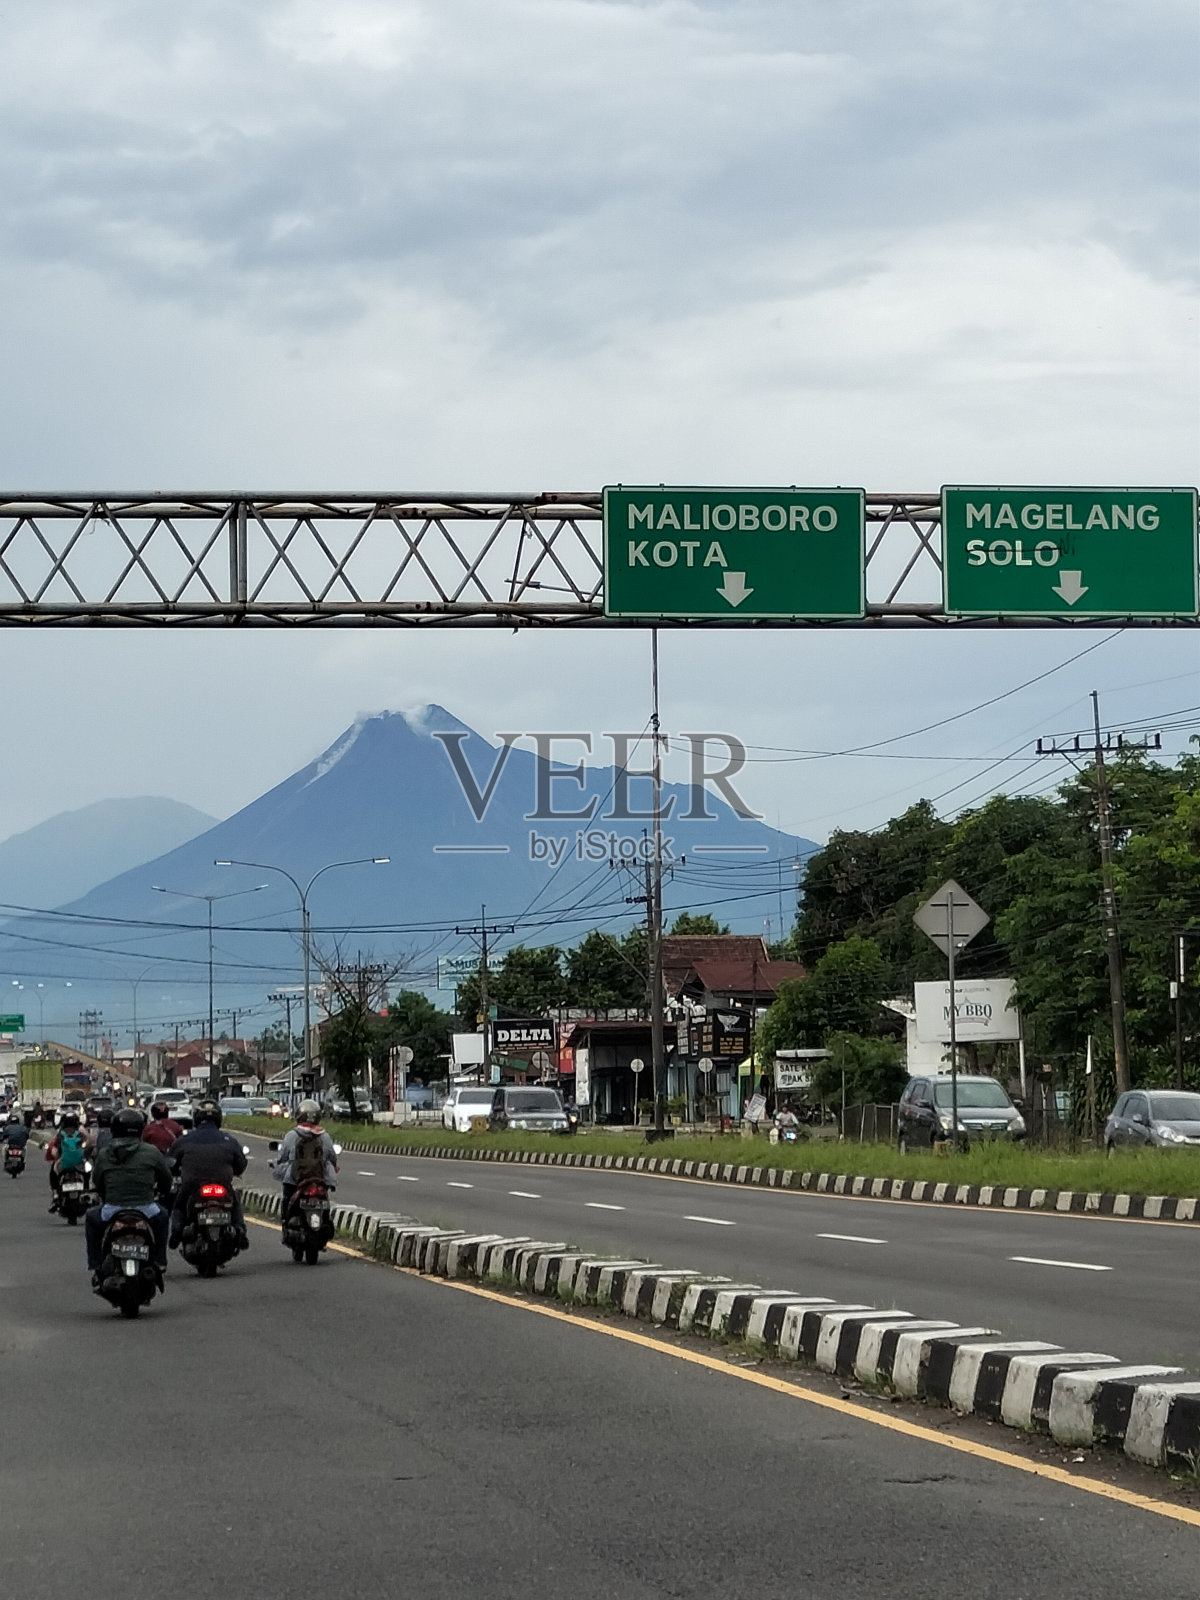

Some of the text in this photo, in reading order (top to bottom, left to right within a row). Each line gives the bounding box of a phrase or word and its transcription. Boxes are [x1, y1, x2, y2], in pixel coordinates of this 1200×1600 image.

[628, 503, 838, 533] MALIOBORO
[965, 503, 1160, 531] MAGELANG
[627, 540, 728, 568] KOTA
[966, 539, 1060, 567] SOLO
[966, 1003, 993, 1021] BBQ
[497, 1028, 552, 1042] DELTA
[779, 1064, 800, 1073] SATE
